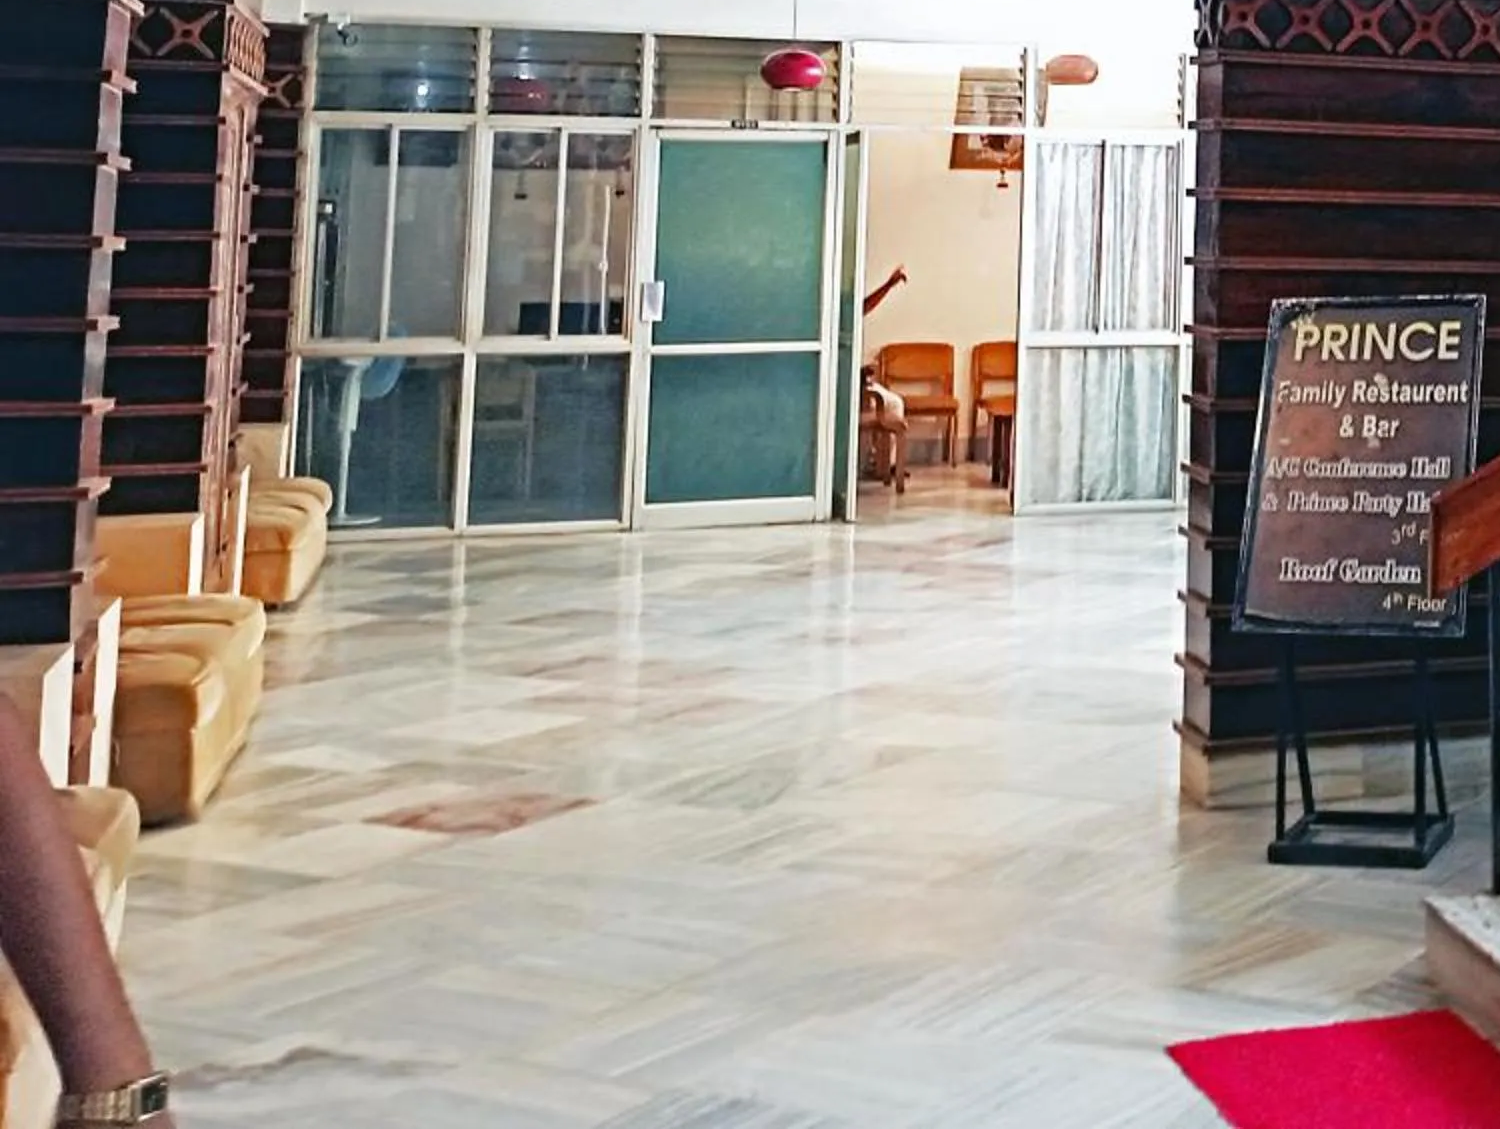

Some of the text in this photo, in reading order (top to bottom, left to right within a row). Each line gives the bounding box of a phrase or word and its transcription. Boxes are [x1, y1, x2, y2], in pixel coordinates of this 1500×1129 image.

[1293, 320, 1461, 362] PRINCE
[1277, 379, 1469, 408] Family Restaurent
[1339, 414, 1399, 439] & Bar
[1407, 594, 1448, 613] Floor
